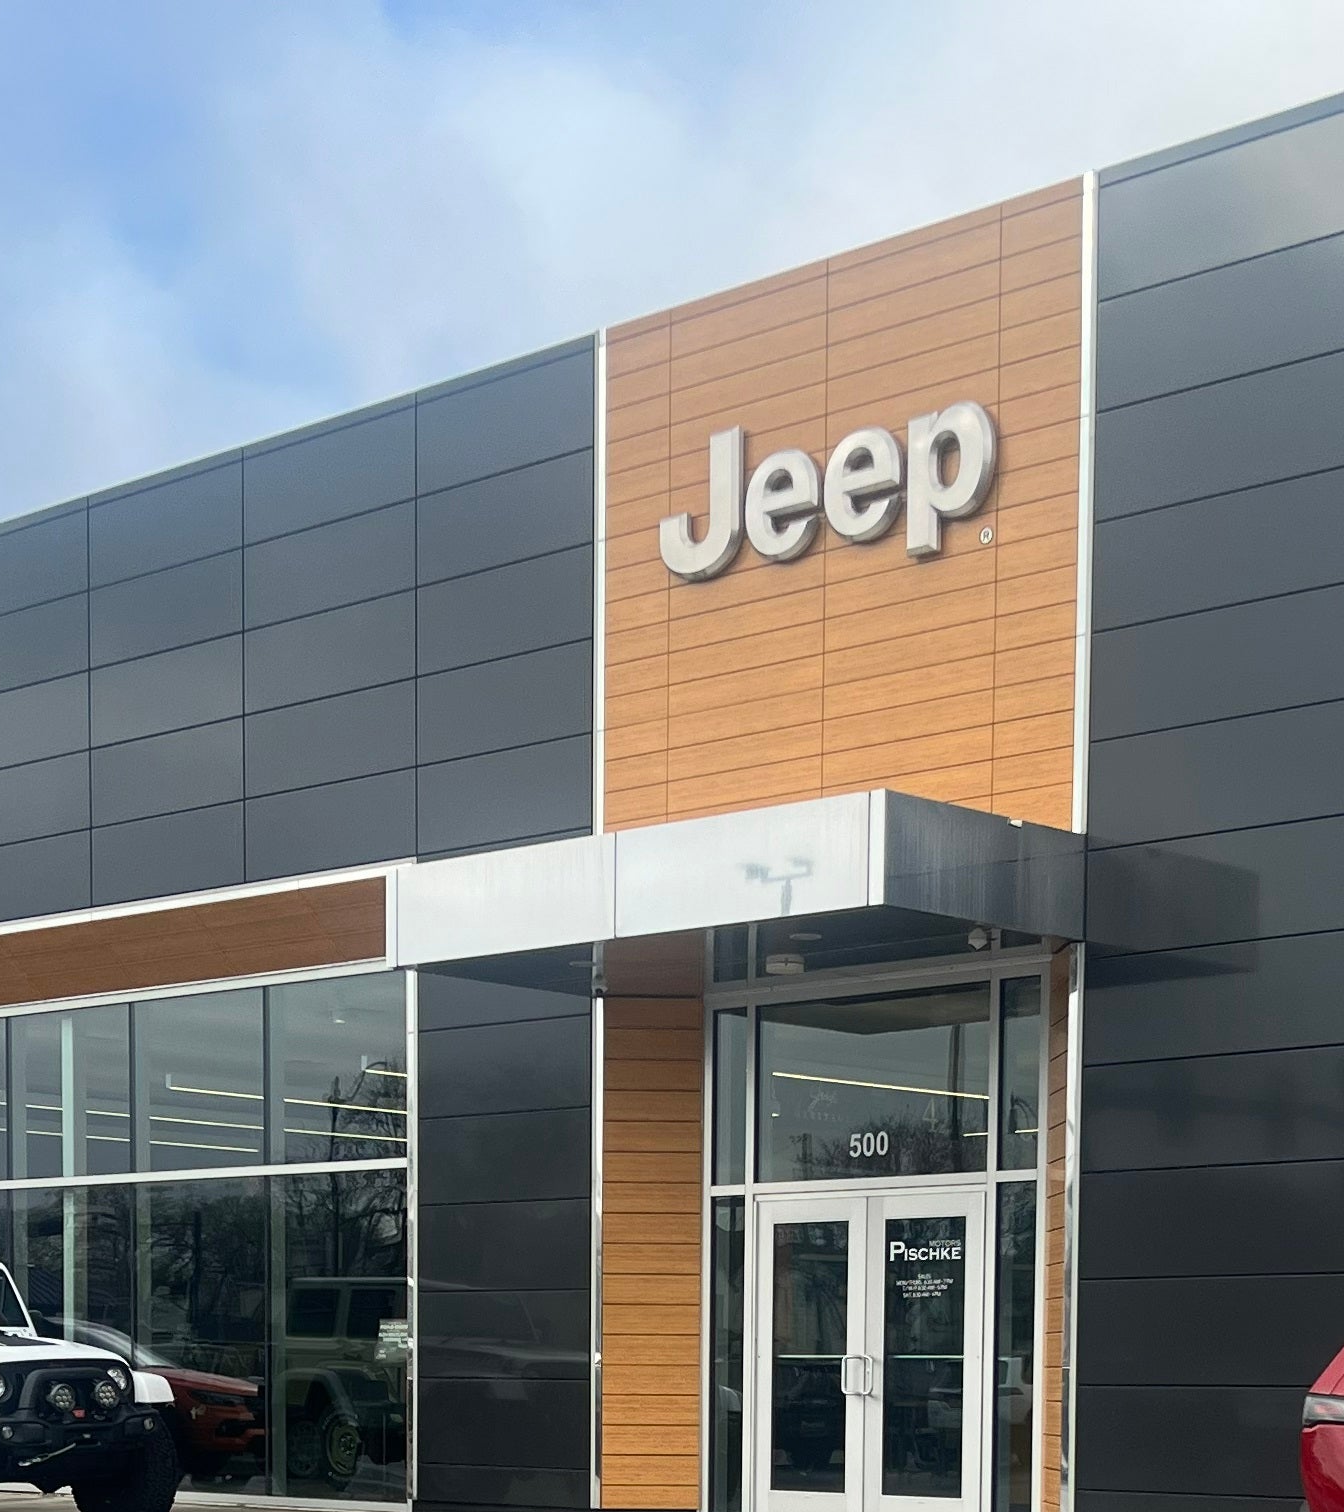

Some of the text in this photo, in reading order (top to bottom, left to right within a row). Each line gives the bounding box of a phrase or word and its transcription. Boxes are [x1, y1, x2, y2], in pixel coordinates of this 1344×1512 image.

[659, 400, 997, 581] Jeep
[849, 1131, 889, 1158] 500
[889, 1241, 962, 1262] PISCHKE
[928, 1239, 962, 1247] MOTORS
